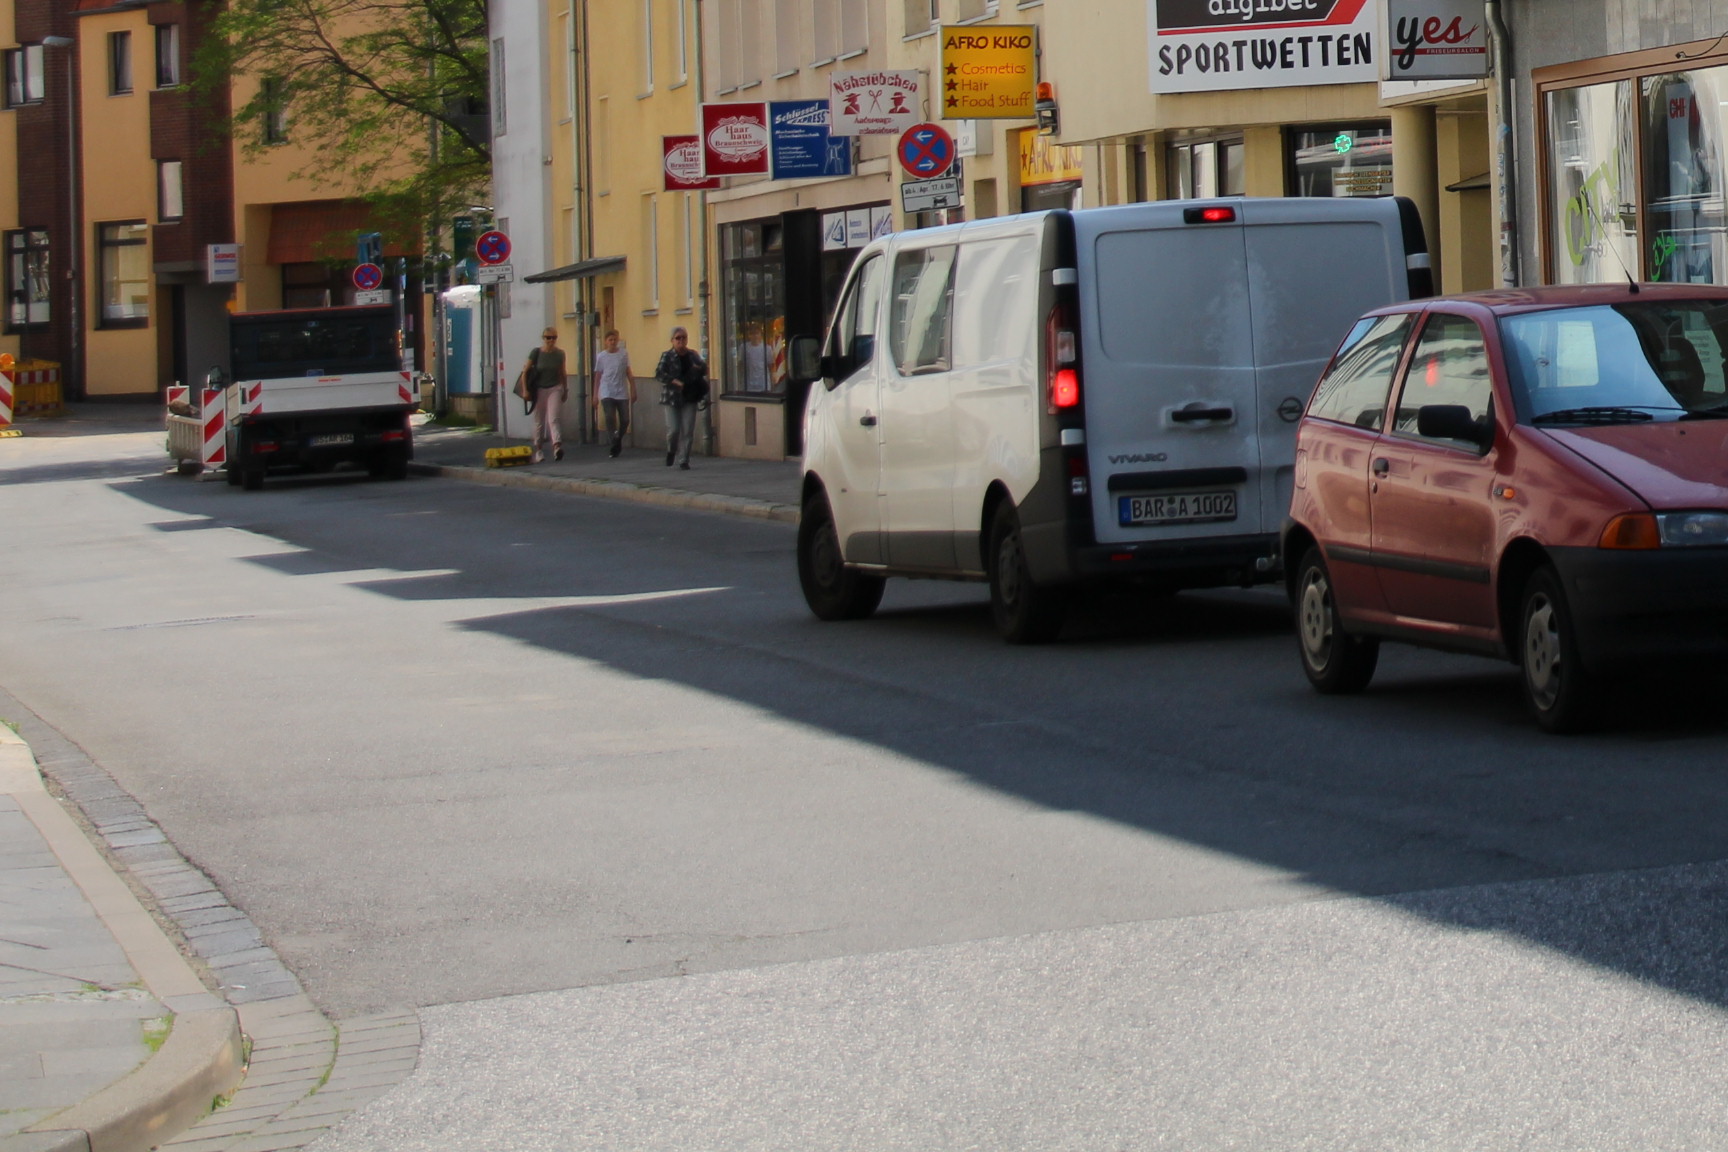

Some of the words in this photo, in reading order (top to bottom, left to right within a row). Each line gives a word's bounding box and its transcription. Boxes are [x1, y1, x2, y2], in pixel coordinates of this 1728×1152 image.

[944, 36, 989, 50] AFRO
[993, 35, 1032, 49] KIKO
[1396, 15, 1463, 70] yes
[1158, 31, 1372, 76] SPORTWETTEN
[1426, 47, 1480, 55] FRISEURSALON
[961, 63, 1026, 76] Cosmetics
[833, 72, 918, 95] Nähstübchen
[961, 79, 990, 92] Hair
[962, 95, 995, 108] Food
[999, 92, 1032, 108] Stuff
[775, 101, 820, 125] Schlüssel
[725, 125, 750, 136] Haar
[730, 131, 753, 140] haus
[715, 139, 764, 148] Braunschweig
[684, 153, 700, 163] hau
[1108, 452, 1168, 464] VIVARO
[1131, 500, 1165, 520] BAR
[1178, 500, 1189, 517] A
[1192, 495, 1235, 516] 1002
